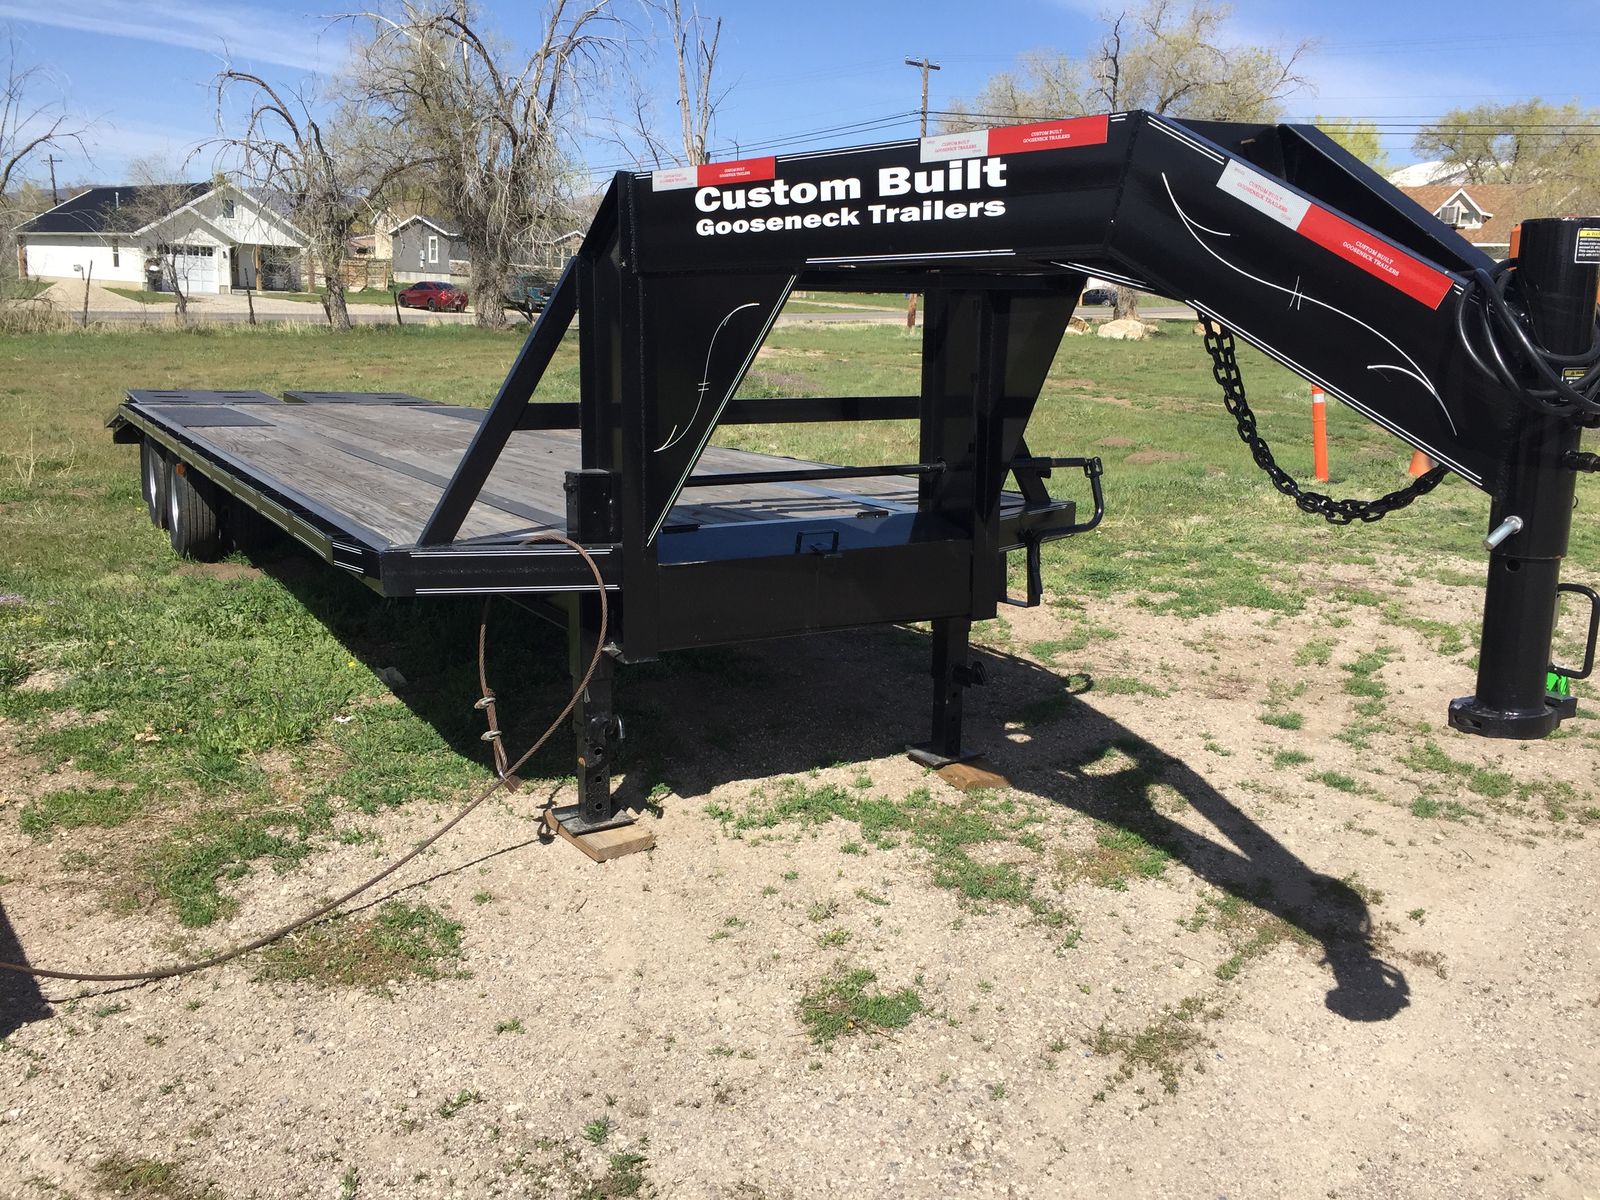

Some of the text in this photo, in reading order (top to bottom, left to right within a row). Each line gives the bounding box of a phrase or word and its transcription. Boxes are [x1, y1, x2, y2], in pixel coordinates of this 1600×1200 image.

[694, 157, 1008, 213] Custom Built
[695, 200, 1007, 237] Gooseneck Trailers
[1355, 240, 1394, 265] CUSTOM BUILT
[1373, 258, 1400, 277] TRAILERS
